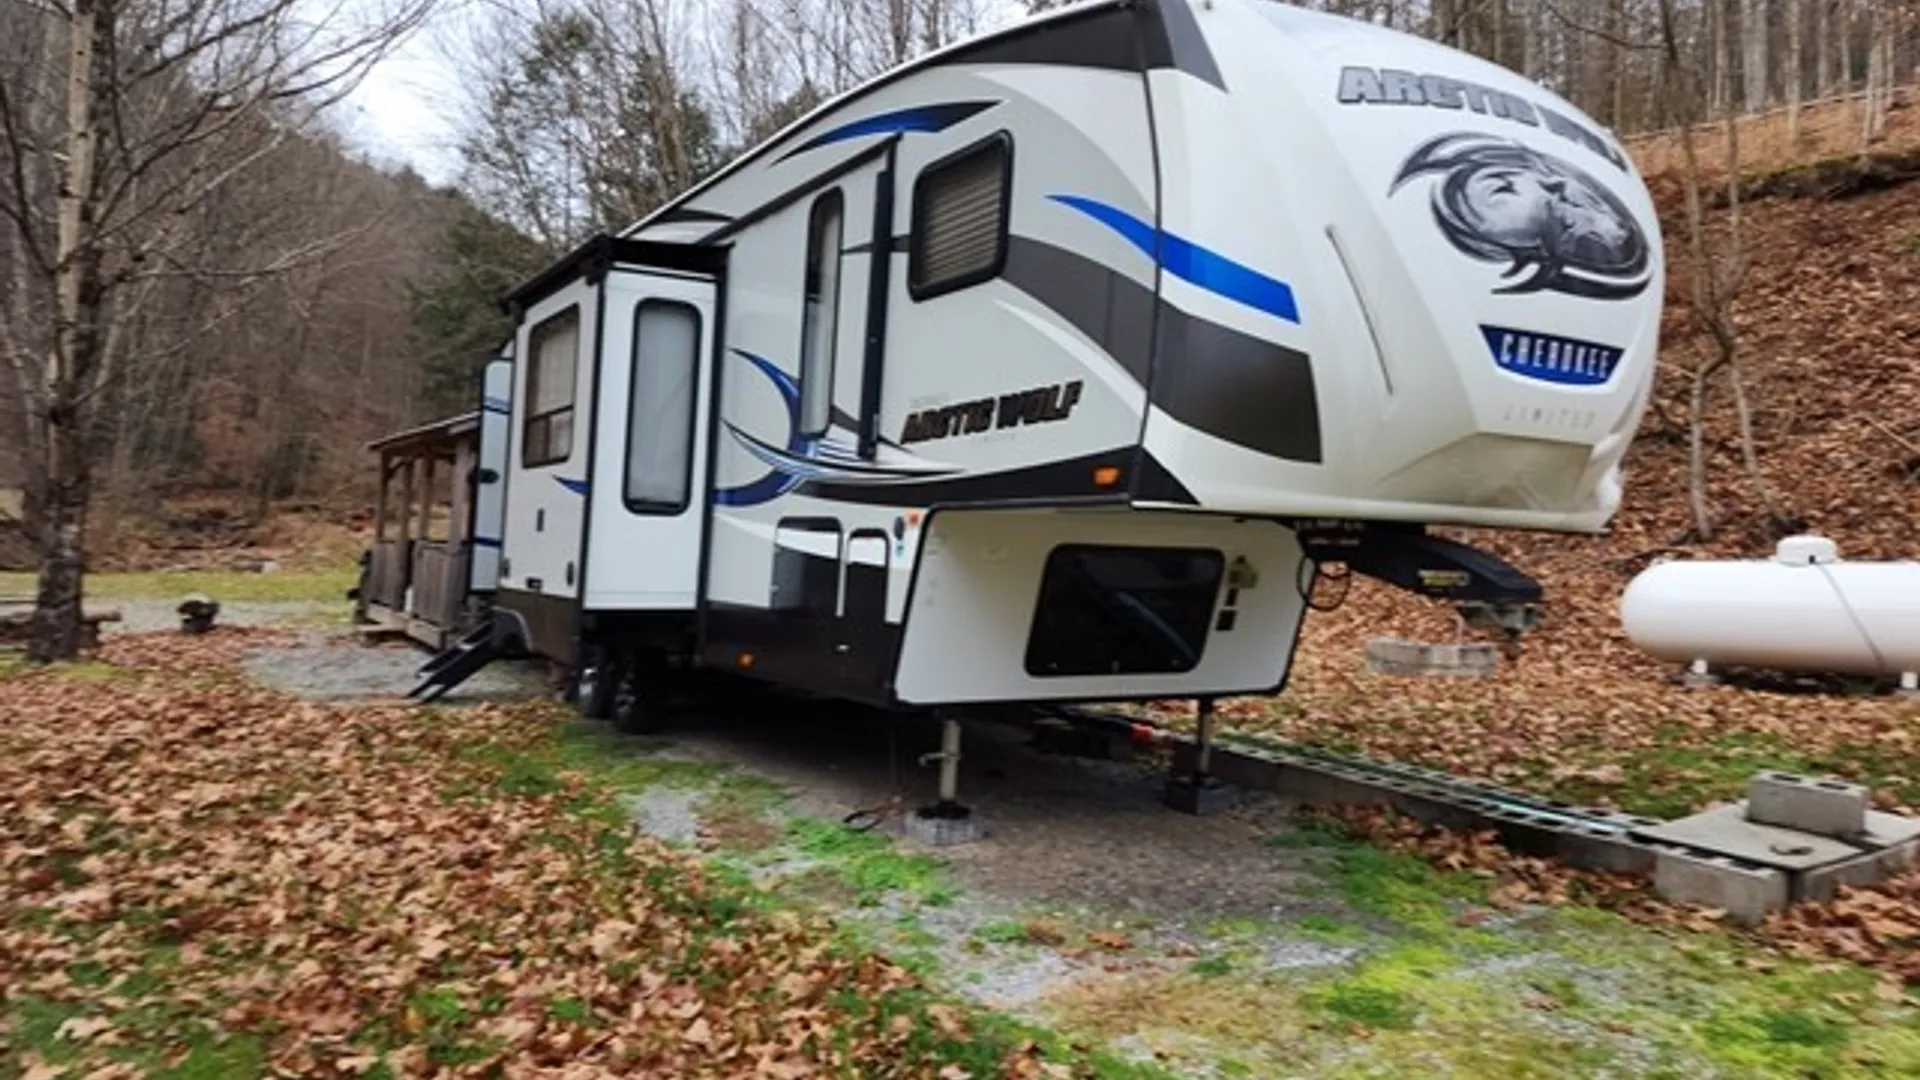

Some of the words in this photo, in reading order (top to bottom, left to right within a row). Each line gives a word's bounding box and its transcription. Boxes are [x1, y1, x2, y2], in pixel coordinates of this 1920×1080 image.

[1337, 65, 1539, 128] ARCTIC
[1500, 332, 1611, 379] CHEROKEE
[900, 397, 996, 445] ARCTIC
[995, 379, 1084, 430] WOLF
